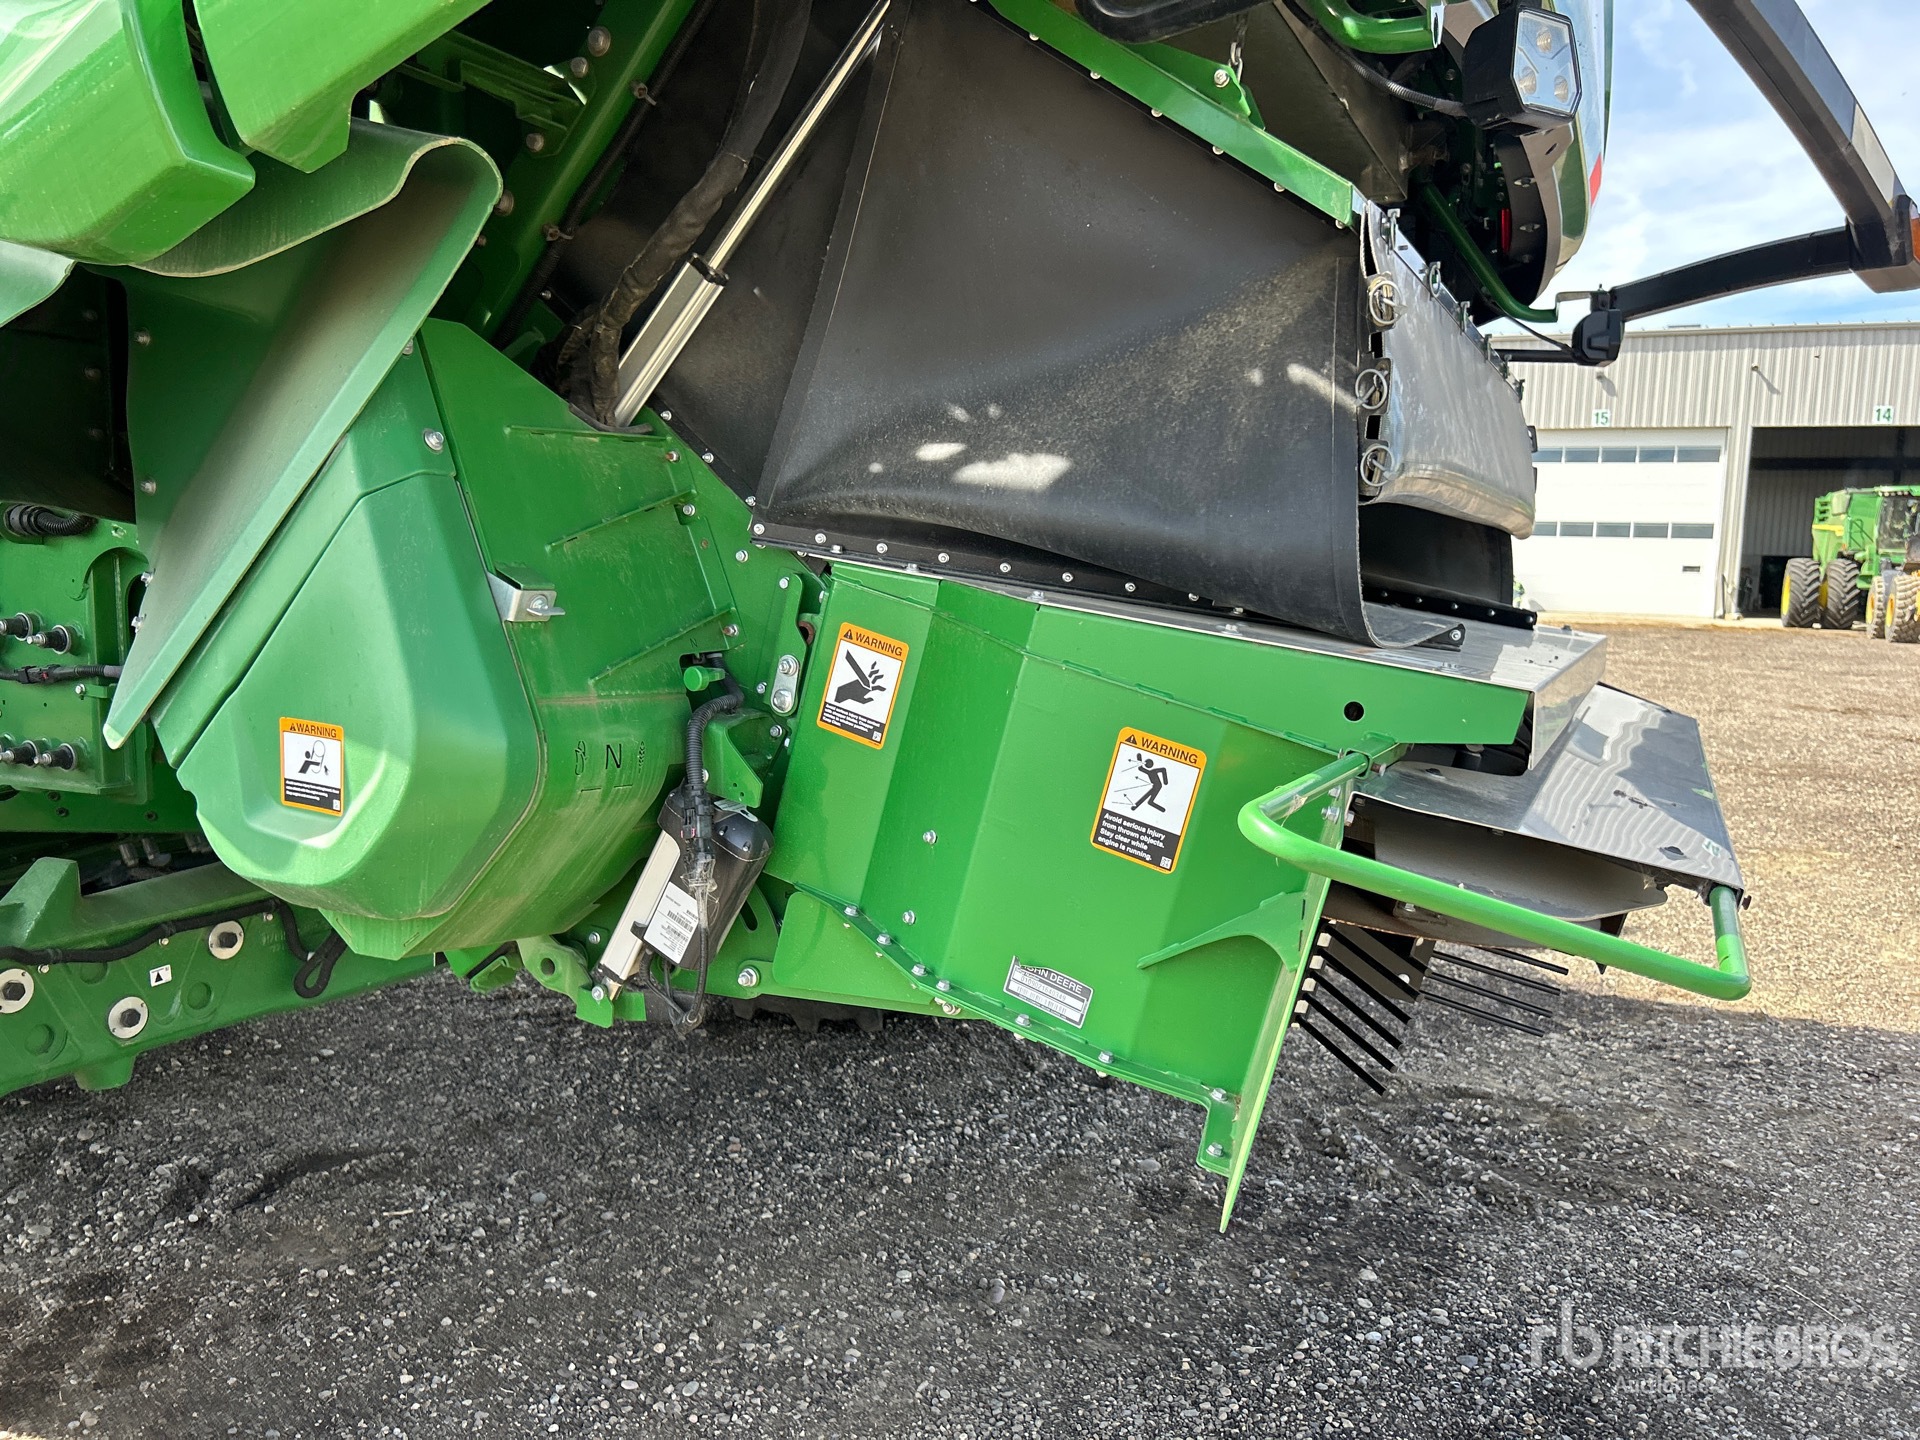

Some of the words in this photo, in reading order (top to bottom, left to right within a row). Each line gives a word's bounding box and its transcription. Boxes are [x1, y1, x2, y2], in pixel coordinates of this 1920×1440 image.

[1594, 411, 1608, 426] 15
[1876, 408, 1892, 421] 14
[856, 632, 903, 657] WARNING
[296, 723, 337, 738] WARNING
[604, 743, 622, 770] N
[1141, 737, 1198, 765] WARNING
[1100, 827, 1114, 839] Stay
[1114, 834, 1131, 843] clear
[1131, 840, 1148, 850] while
[1102, 820, 1118, 831] from
[1118, 825, 1140, 839] thrown
[1140, 834, 1165, 849] objects.
[1104, 813, 1123, 822] Avoid
[1123, 819, 1147, 833] serious
[1147, 827, 1165, 841] injury
[1098, 835, 1119, 848] engine
[1126, 845, 1152, 861] running.
[1050, 973, 1083, 994] DEERE
